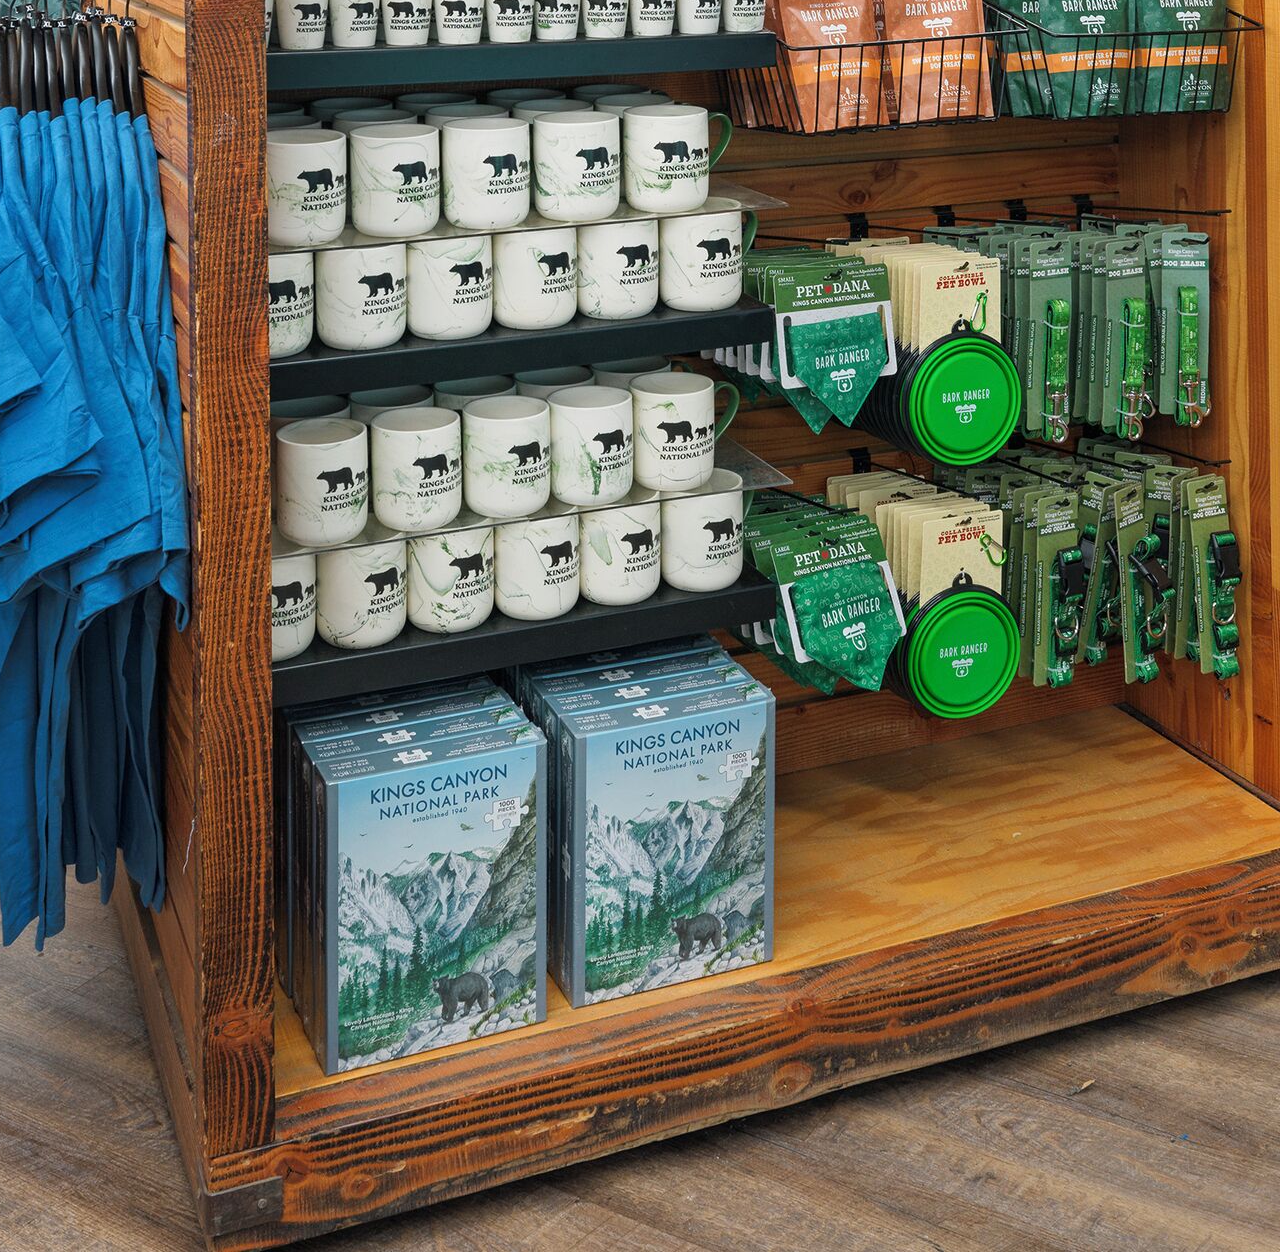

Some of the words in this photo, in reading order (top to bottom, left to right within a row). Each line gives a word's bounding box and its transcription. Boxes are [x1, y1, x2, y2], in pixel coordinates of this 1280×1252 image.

[906, 3, 928, 16] BARK
[932, 0, 968, 14] RANGER
[1062, 0, 1084, 12] BARK
[1086, 0, 1118, 11] RANGER
[801, 10, 822, 22] BARK
[824, 7, 859, 19] RANGER
[658, 172, 697, 180] NATIONAL
[304, 194, 329, 203] KINGS
[301, 201, 339, 211] NATIONAL
[702, 262, 727, 270] KINGS
[700, 270, 738, 279] NATIONAL
[939, 272, 983, 281] COLLAPSIBLE
[1033, 269, 1045, 278] DOG
[1047, 268, 1069, 276] LEASH
[1109, 269, 1120, 277] DOG
[936, 281, 955, 289] PET
[958, 277, 986, 288] BOWL
[796, 284, 824, 298] PET
[834, 280, 870, 290] DANA
[811, 298, 834, 306] CANYON
[816, 356, 836, 370] BARK
[839, 349, 870, 364] RANGER
[943, 392, 960, 403] BARK
[964, 389, 990, 401] RANGER
[691, 438, 713, 449] CANYON
[659, 452, 700, 461] NATIONAL
[419, 480, 444, 490] KINGS
[417, 486, 455, 498] NATIONAL
[1193, 511, 1205, 519] DOG
[1206, 508, 1226, 518] COLLAR
[941, 525, 985, 536] COLLAPSIBLE
[1053, 523, 1075, 533] COLLAR
[938, 535, 957, 544] PET
[794, 550, 820, 567] PET
[830, 542, 866, 558] DANA
[794, 567, 810, 576] KINGS
[810, 563, 832, 573] CANYON
[833, 558, 858, 568] NATIONAL
[830, 599, 845, 608] KINGS
[847, 594, 867, 603] CANYON
[822, 610, 846, 628] BARK
[848, 597, 880, 618] RANGER
[940, 647, 958, 659] BARK
[961, 642, 988, 656] RANGER
[616, 734, 665, 755] KINGS
[671, 719, 740, 744] CANYON
[624, 747, 695, 770] NATIONAL
[701, 739, 732, 755] PARK
[654, 762, 687, 773] established
[371, 780, 425, 804] KINGS
[431, 764, 507, 791] CANYON
[380, 795, 458, 820] NATIONAL
[465, 785, 499, 803] PARK
[498, 800, 515, 808] 1000
[498, 805, 516, 813] PIECES
[412, 811, 449, 823] established
[452, 807, 468, 815] 1940
